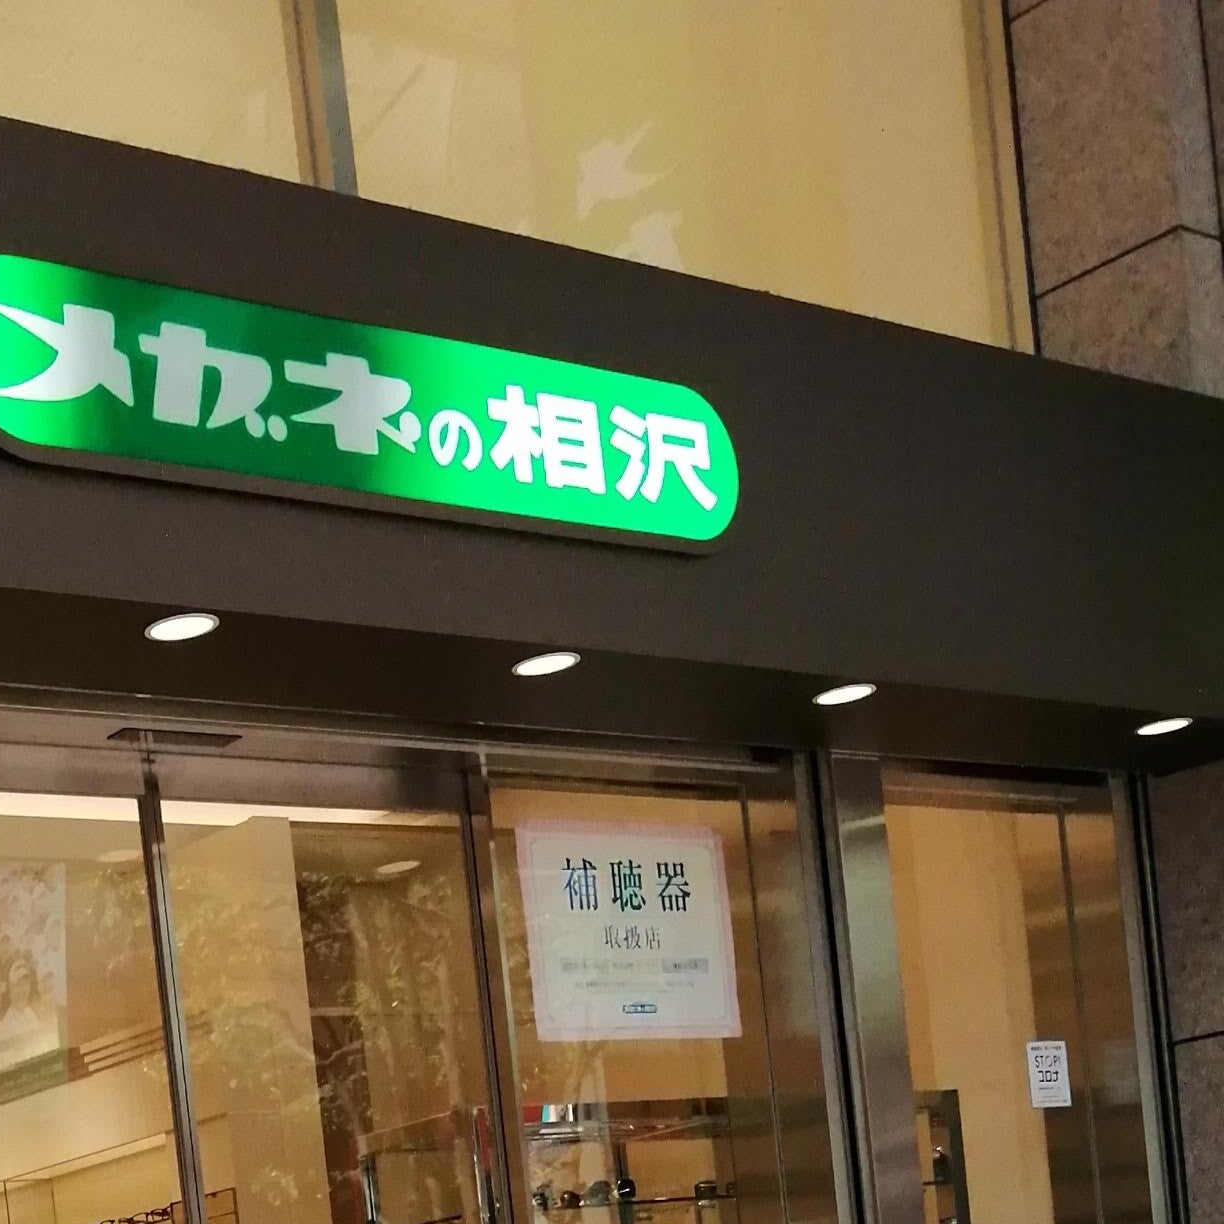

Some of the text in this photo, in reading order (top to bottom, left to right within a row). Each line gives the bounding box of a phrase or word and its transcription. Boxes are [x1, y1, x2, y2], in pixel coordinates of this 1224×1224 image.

[561, 857, 691, 912] 補聴器
[604, 925, 661, 950] 取扱店
